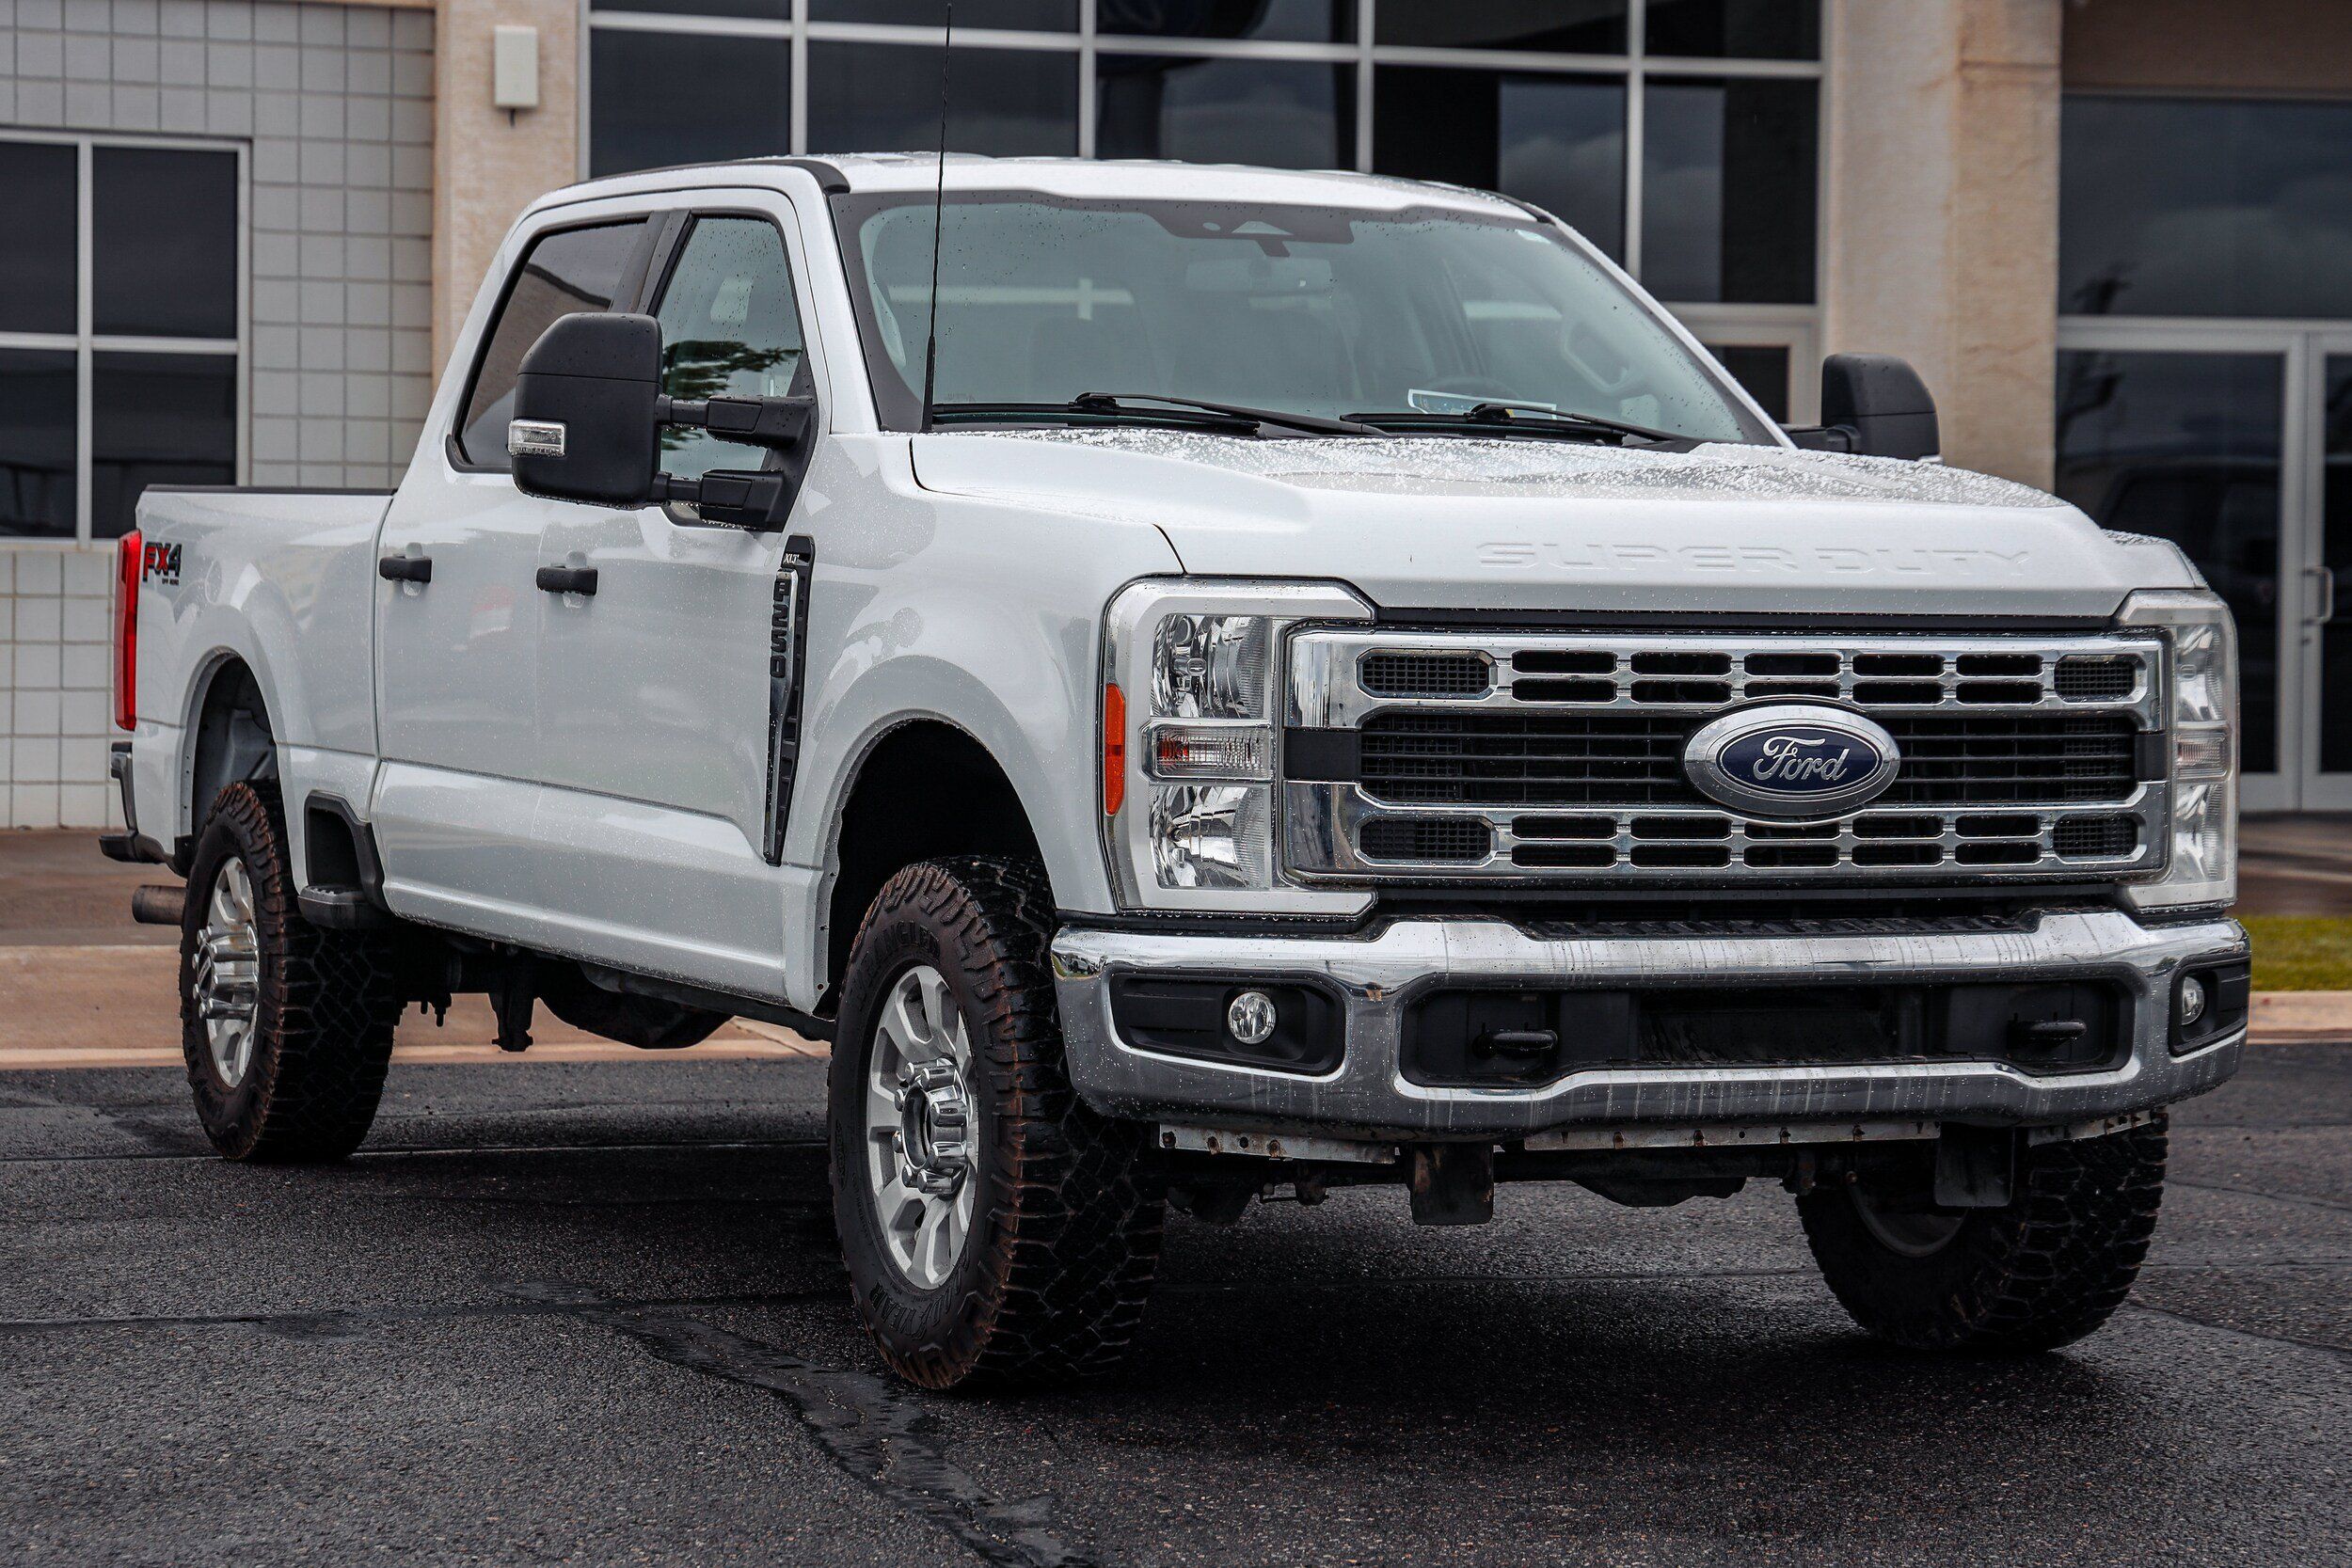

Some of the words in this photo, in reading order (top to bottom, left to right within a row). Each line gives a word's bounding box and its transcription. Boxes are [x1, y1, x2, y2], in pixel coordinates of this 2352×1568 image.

[142, 542, 183, 582] FX4
[782, 553, 800, 564] XLT
[1476, 542, 1800, 573] SUPER
[1815, 546, 2031, 576] DUTY
[770, 578, 792, 678] F250
[1753, 736, 1850, 781] Ford
